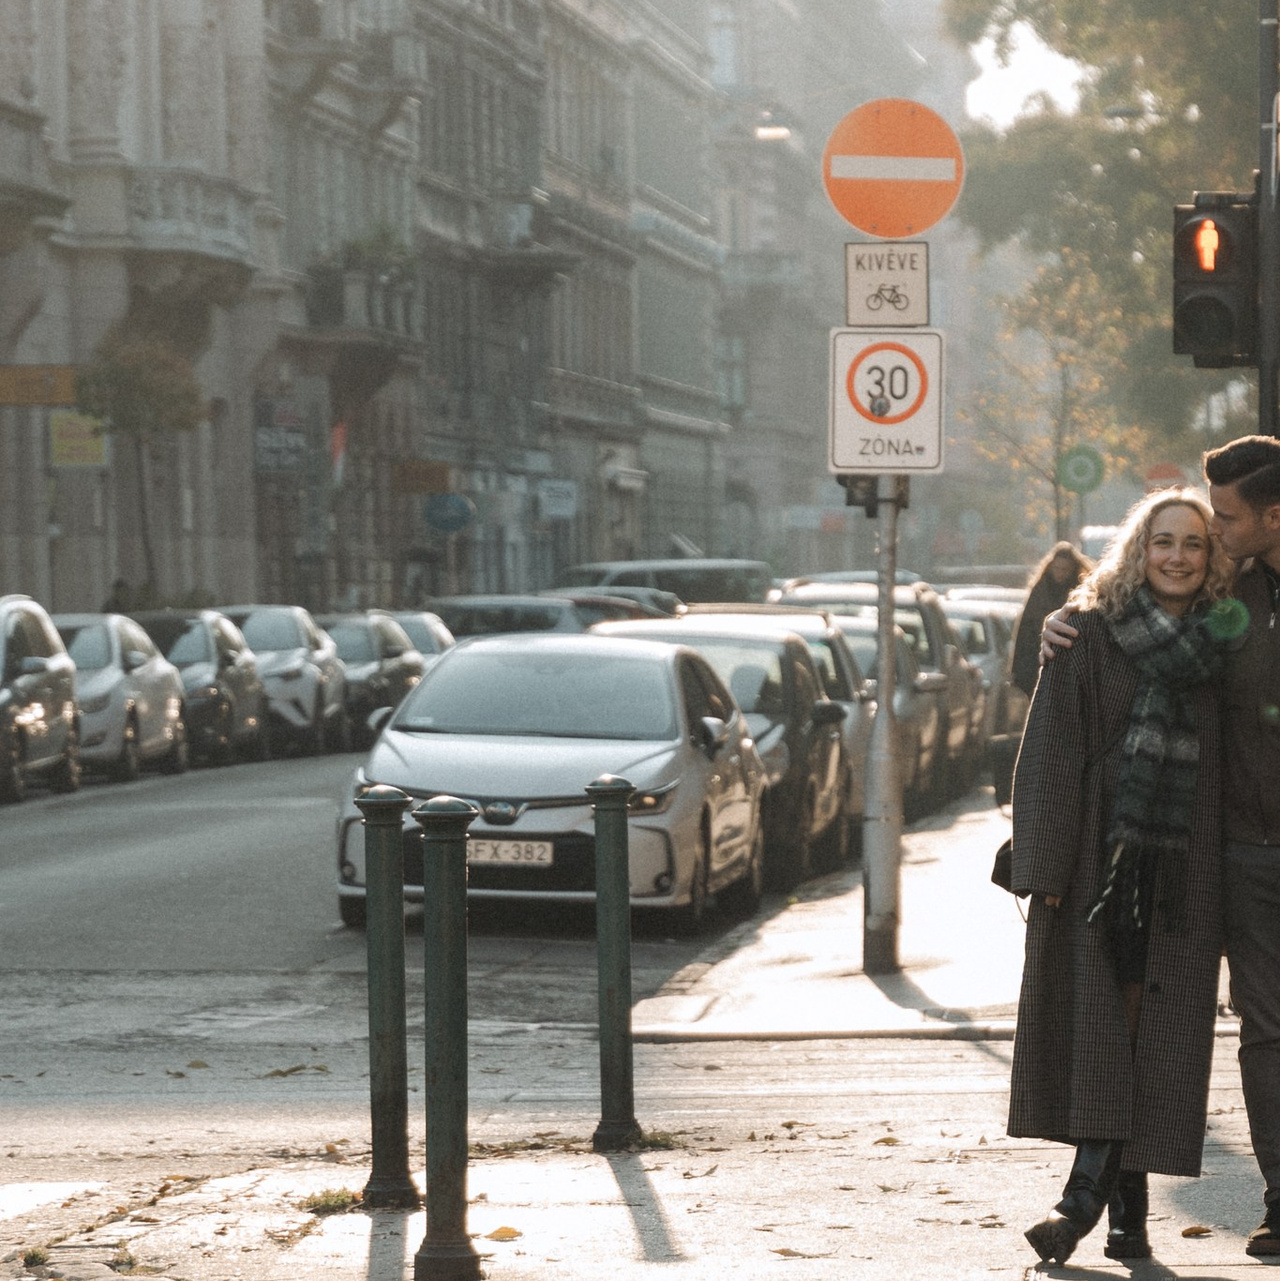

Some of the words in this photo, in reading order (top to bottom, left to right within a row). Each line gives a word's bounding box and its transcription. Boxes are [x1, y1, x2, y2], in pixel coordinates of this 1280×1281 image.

[855, 248, 919, 271] KIVÉVE
[866, 364, 909, 401] 30
[858, 433, 914, 456] ZÓNA
